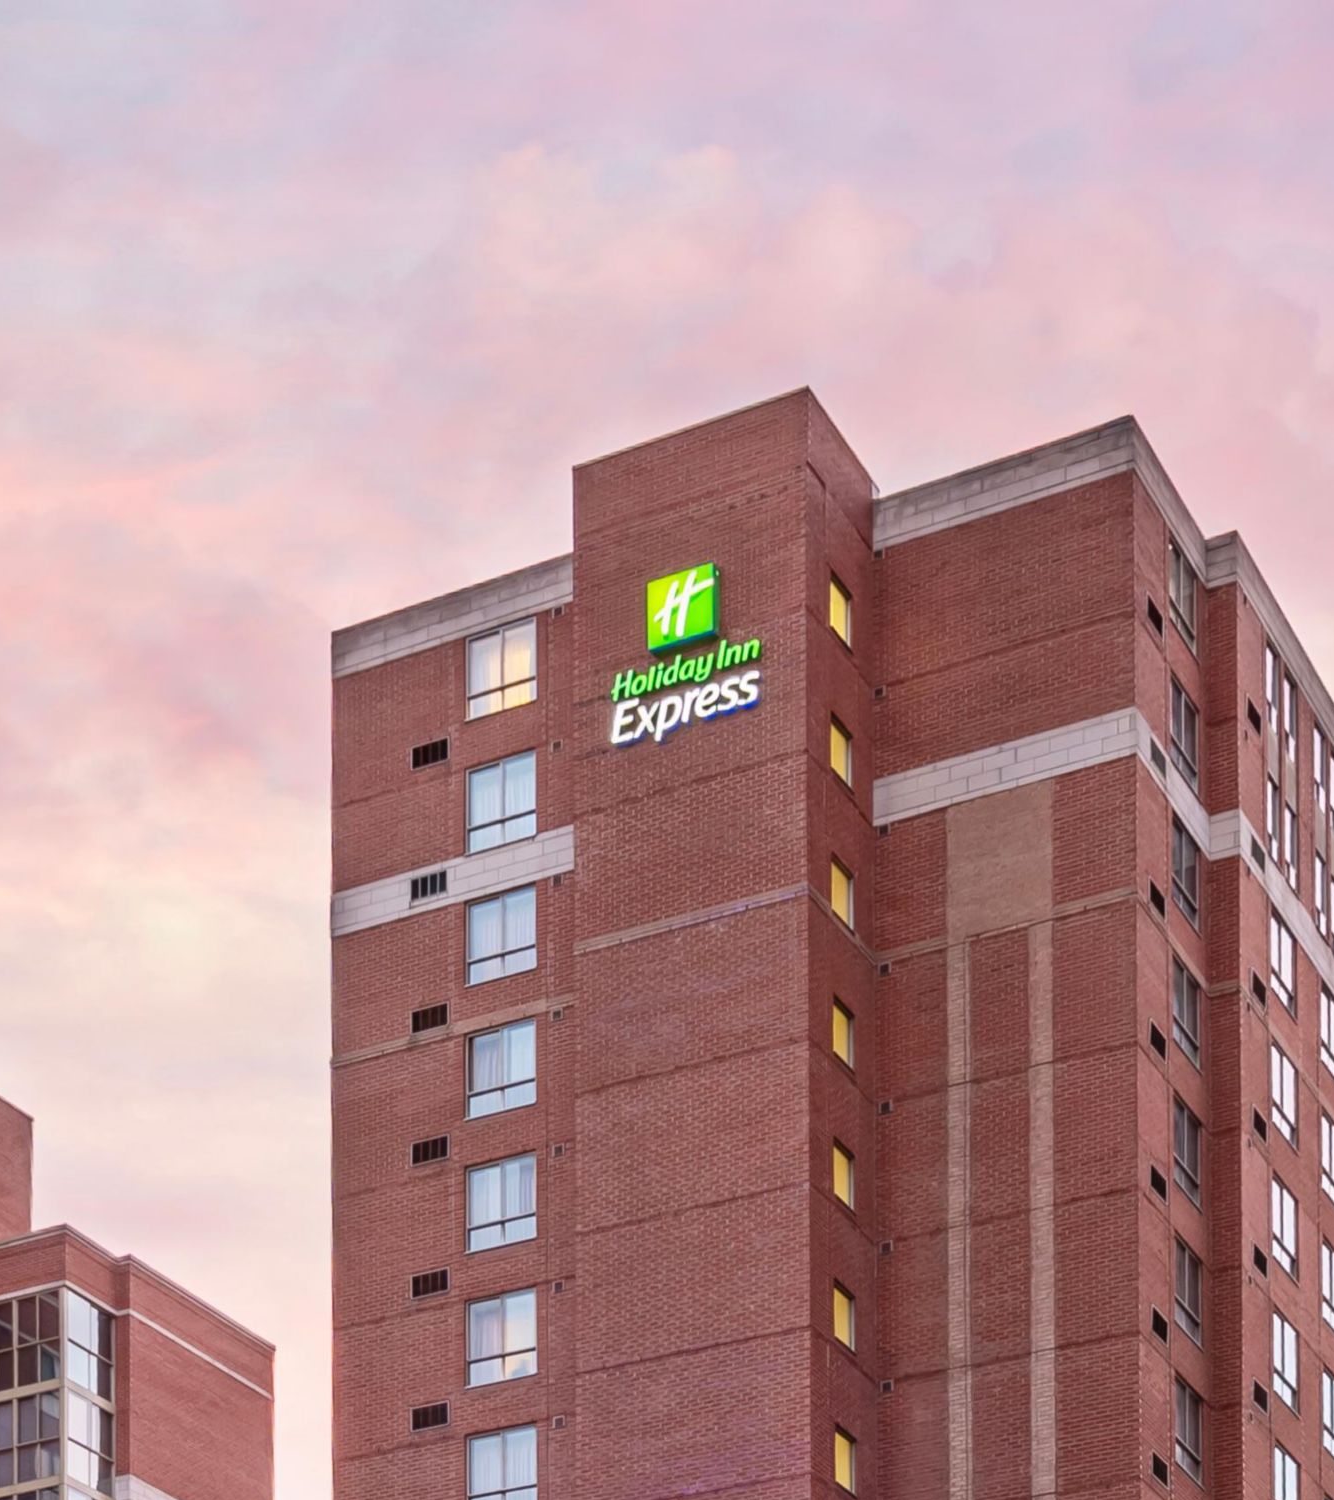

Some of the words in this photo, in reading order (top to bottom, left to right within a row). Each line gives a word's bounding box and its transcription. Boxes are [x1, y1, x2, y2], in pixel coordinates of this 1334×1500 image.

[610, 652, 714, 702] Holiday
[716, 638, 761, 671] Inn
[610, 670, 761, 745] Express
